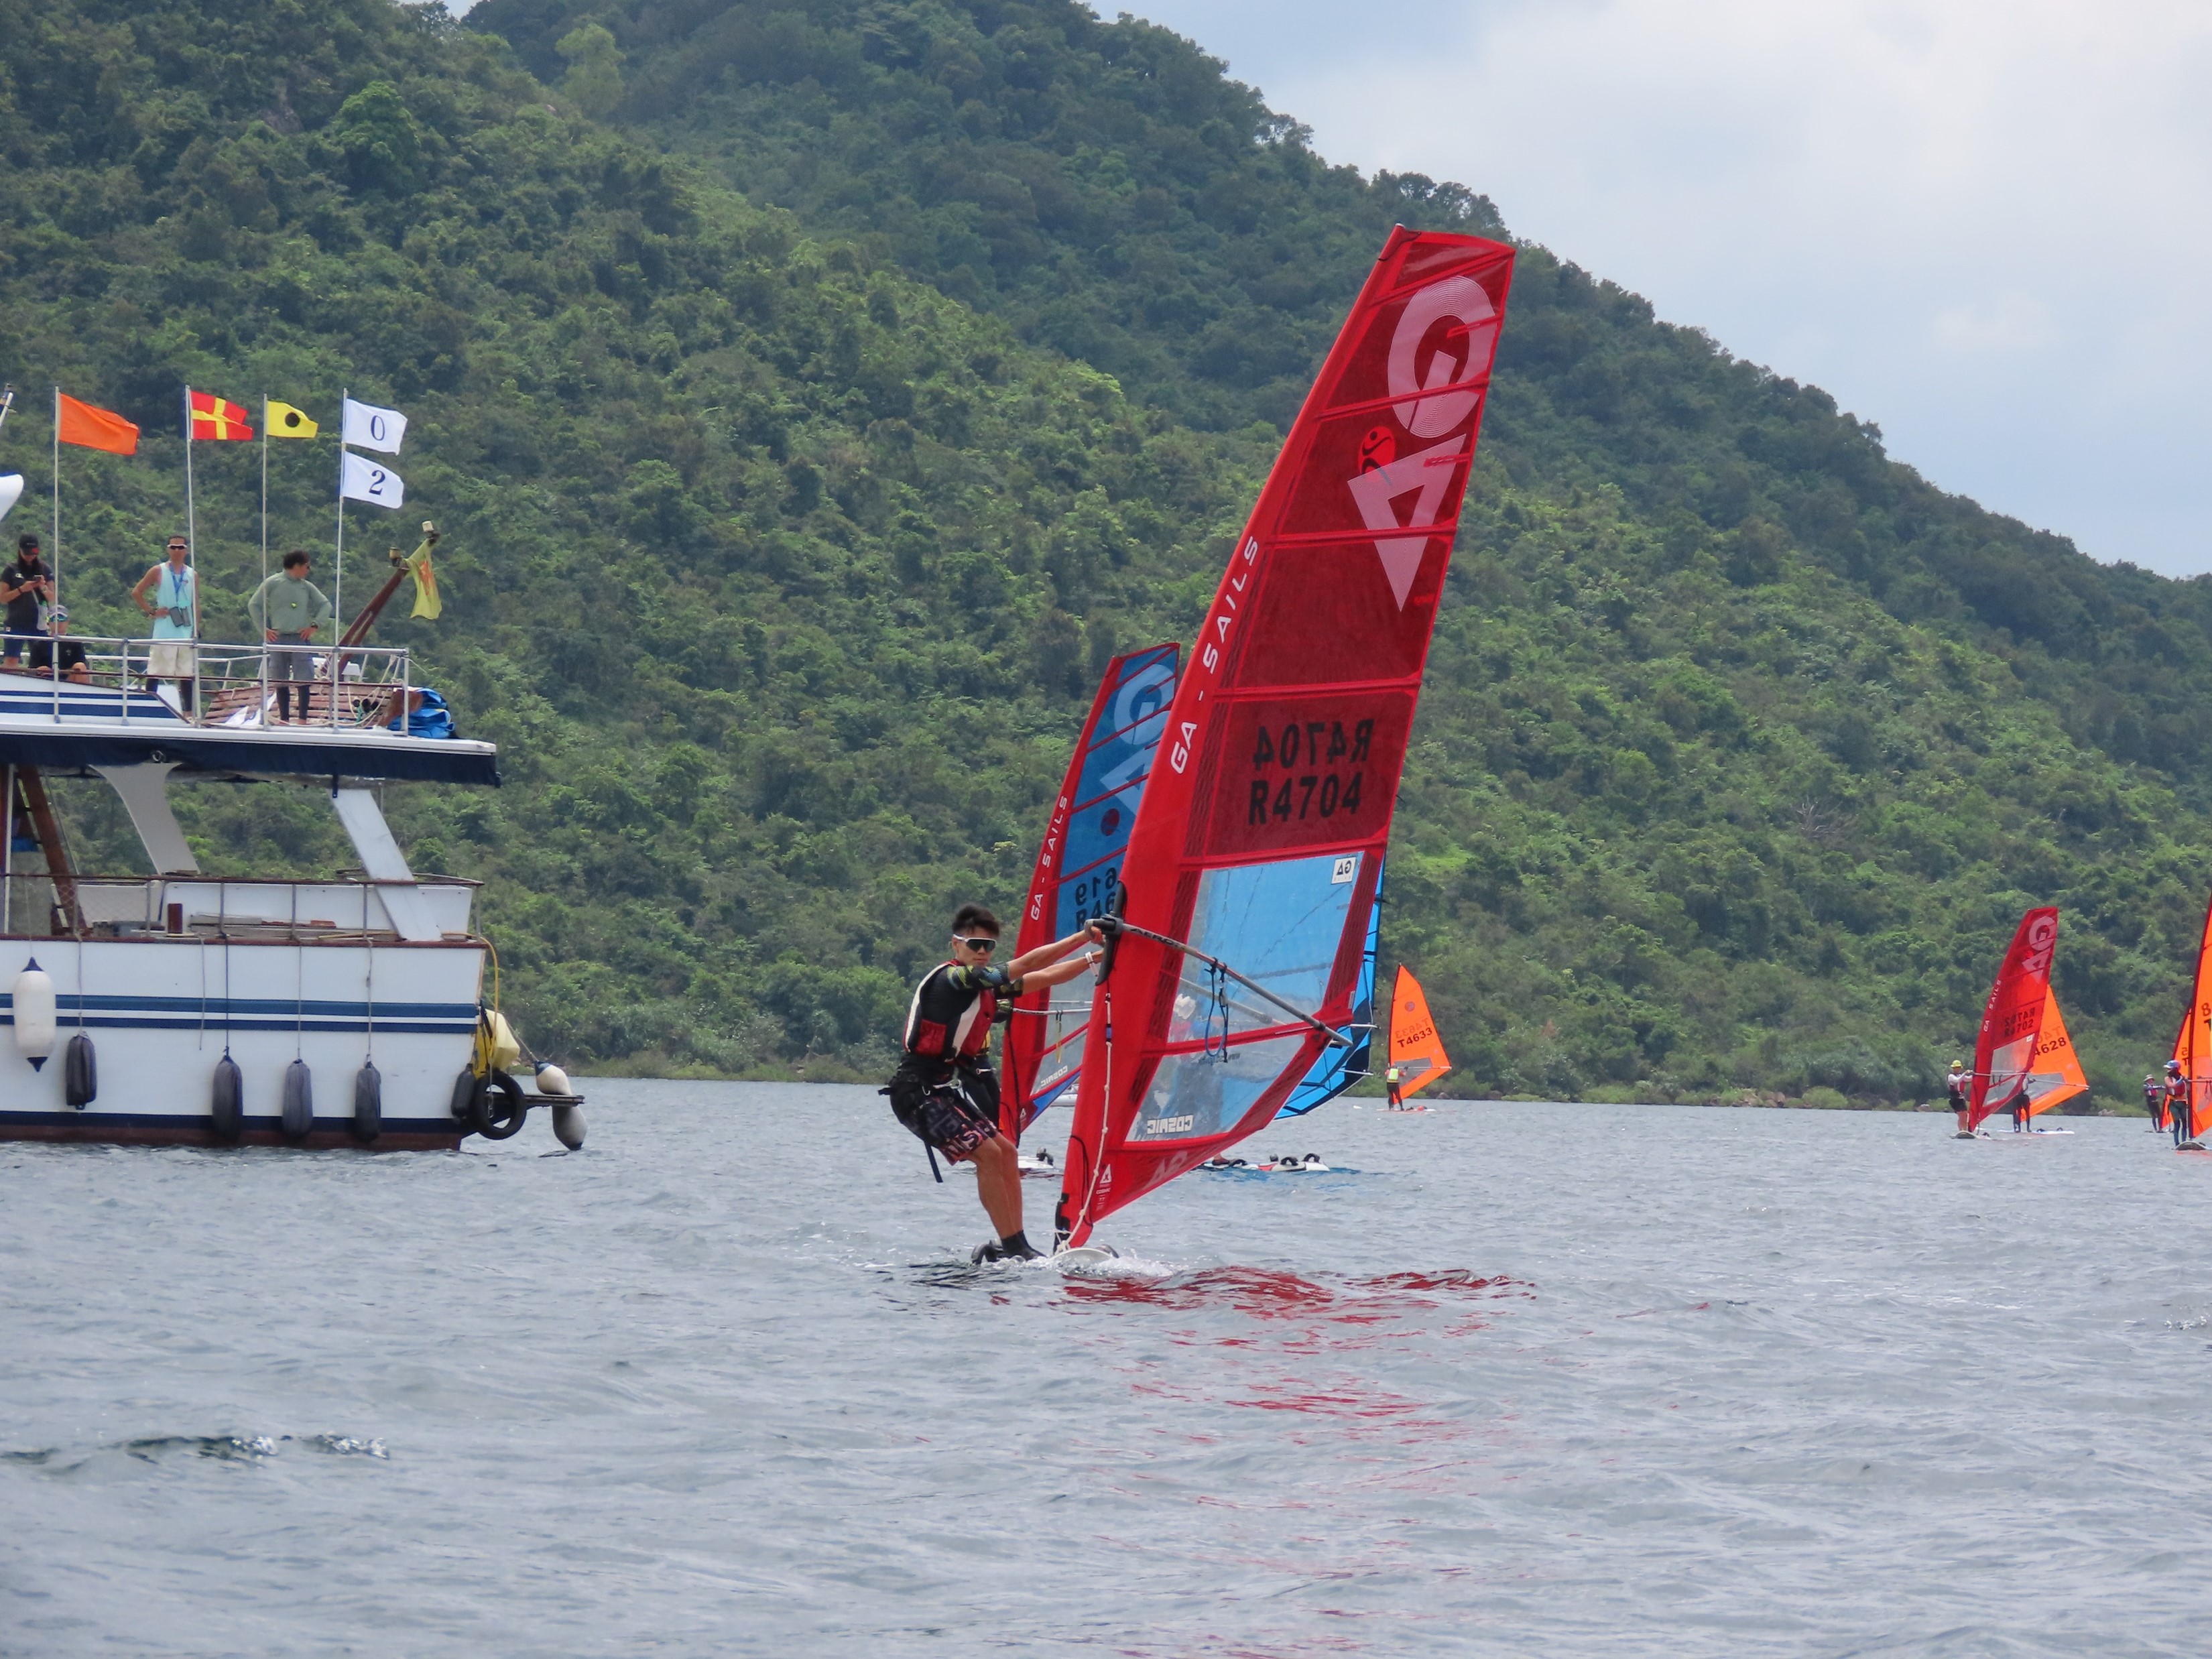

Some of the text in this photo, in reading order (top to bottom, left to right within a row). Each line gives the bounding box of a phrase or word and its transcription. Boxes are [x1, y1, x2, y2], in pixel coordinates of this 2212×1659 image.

[369, 470, 385, 495] 2
[1170, 721, 1199, 774] GA
[1203, 536, 1258, 674] SAILS
[1247, 772, 1363, 826] R4704
[1042, 795, 1068, 867] SAILS
[1397, 1027, 1432, 1048] T4633
[2035, 1037, 2067, 1056] 4628
